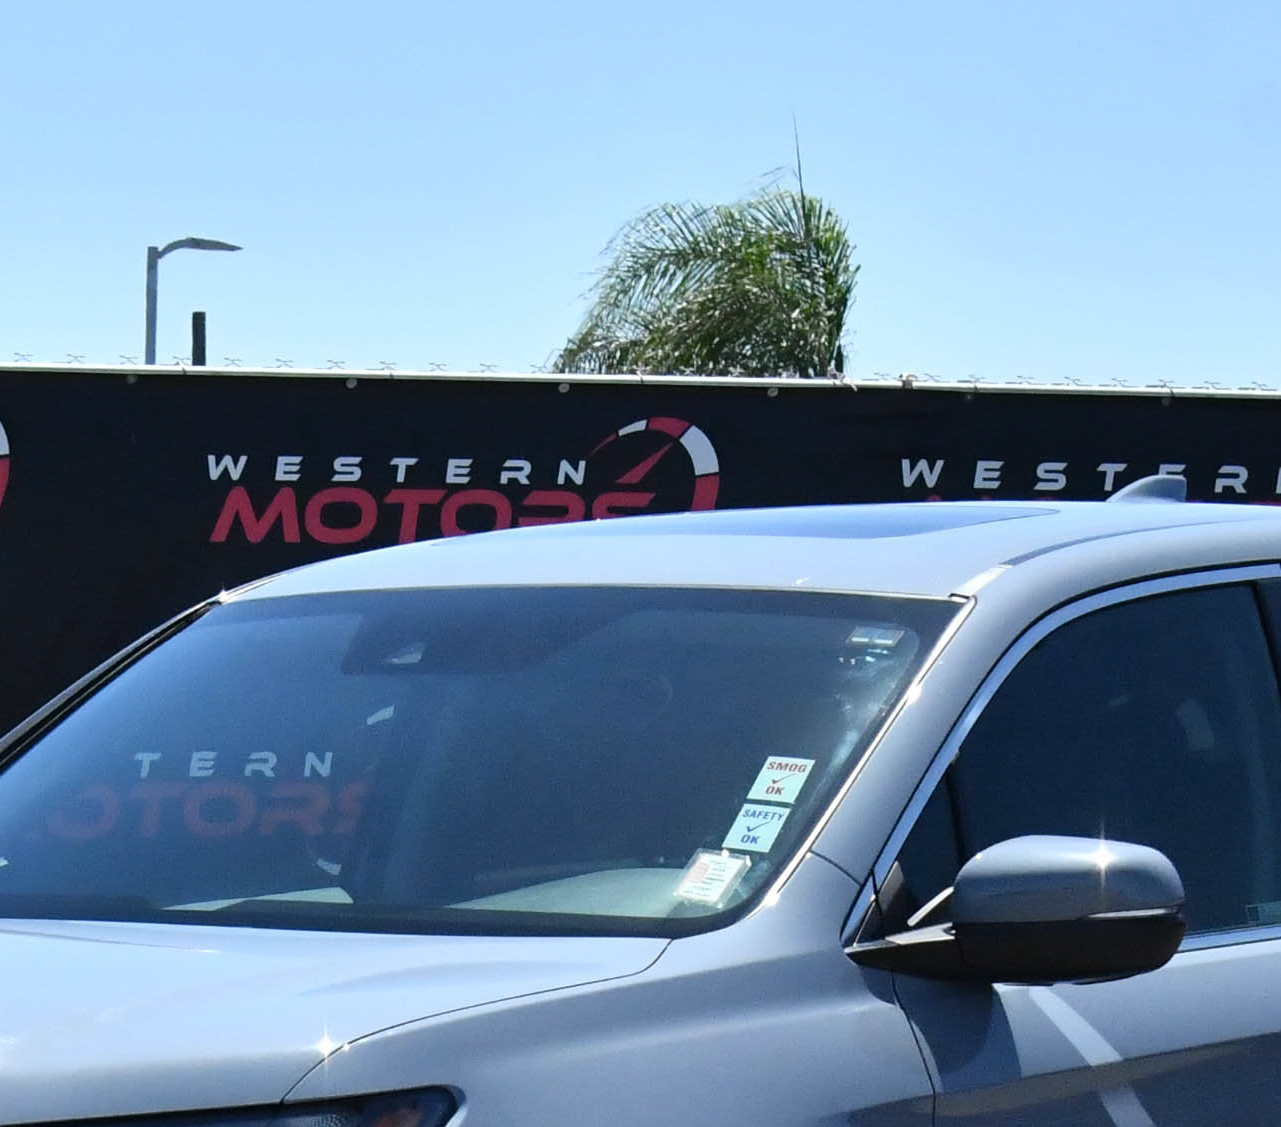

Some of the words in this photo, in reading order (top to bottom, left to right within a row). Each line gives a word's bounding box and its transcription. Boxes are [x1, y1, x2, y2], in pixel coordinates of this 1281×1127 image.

[207, 454, 586, 485] WESTERN
[766, 761, 807, 773] SMOG
[765, 785, 785, 796] OK
[742, 808, 785, 822] SAFETY
[740, 834, 761, 845] OK
